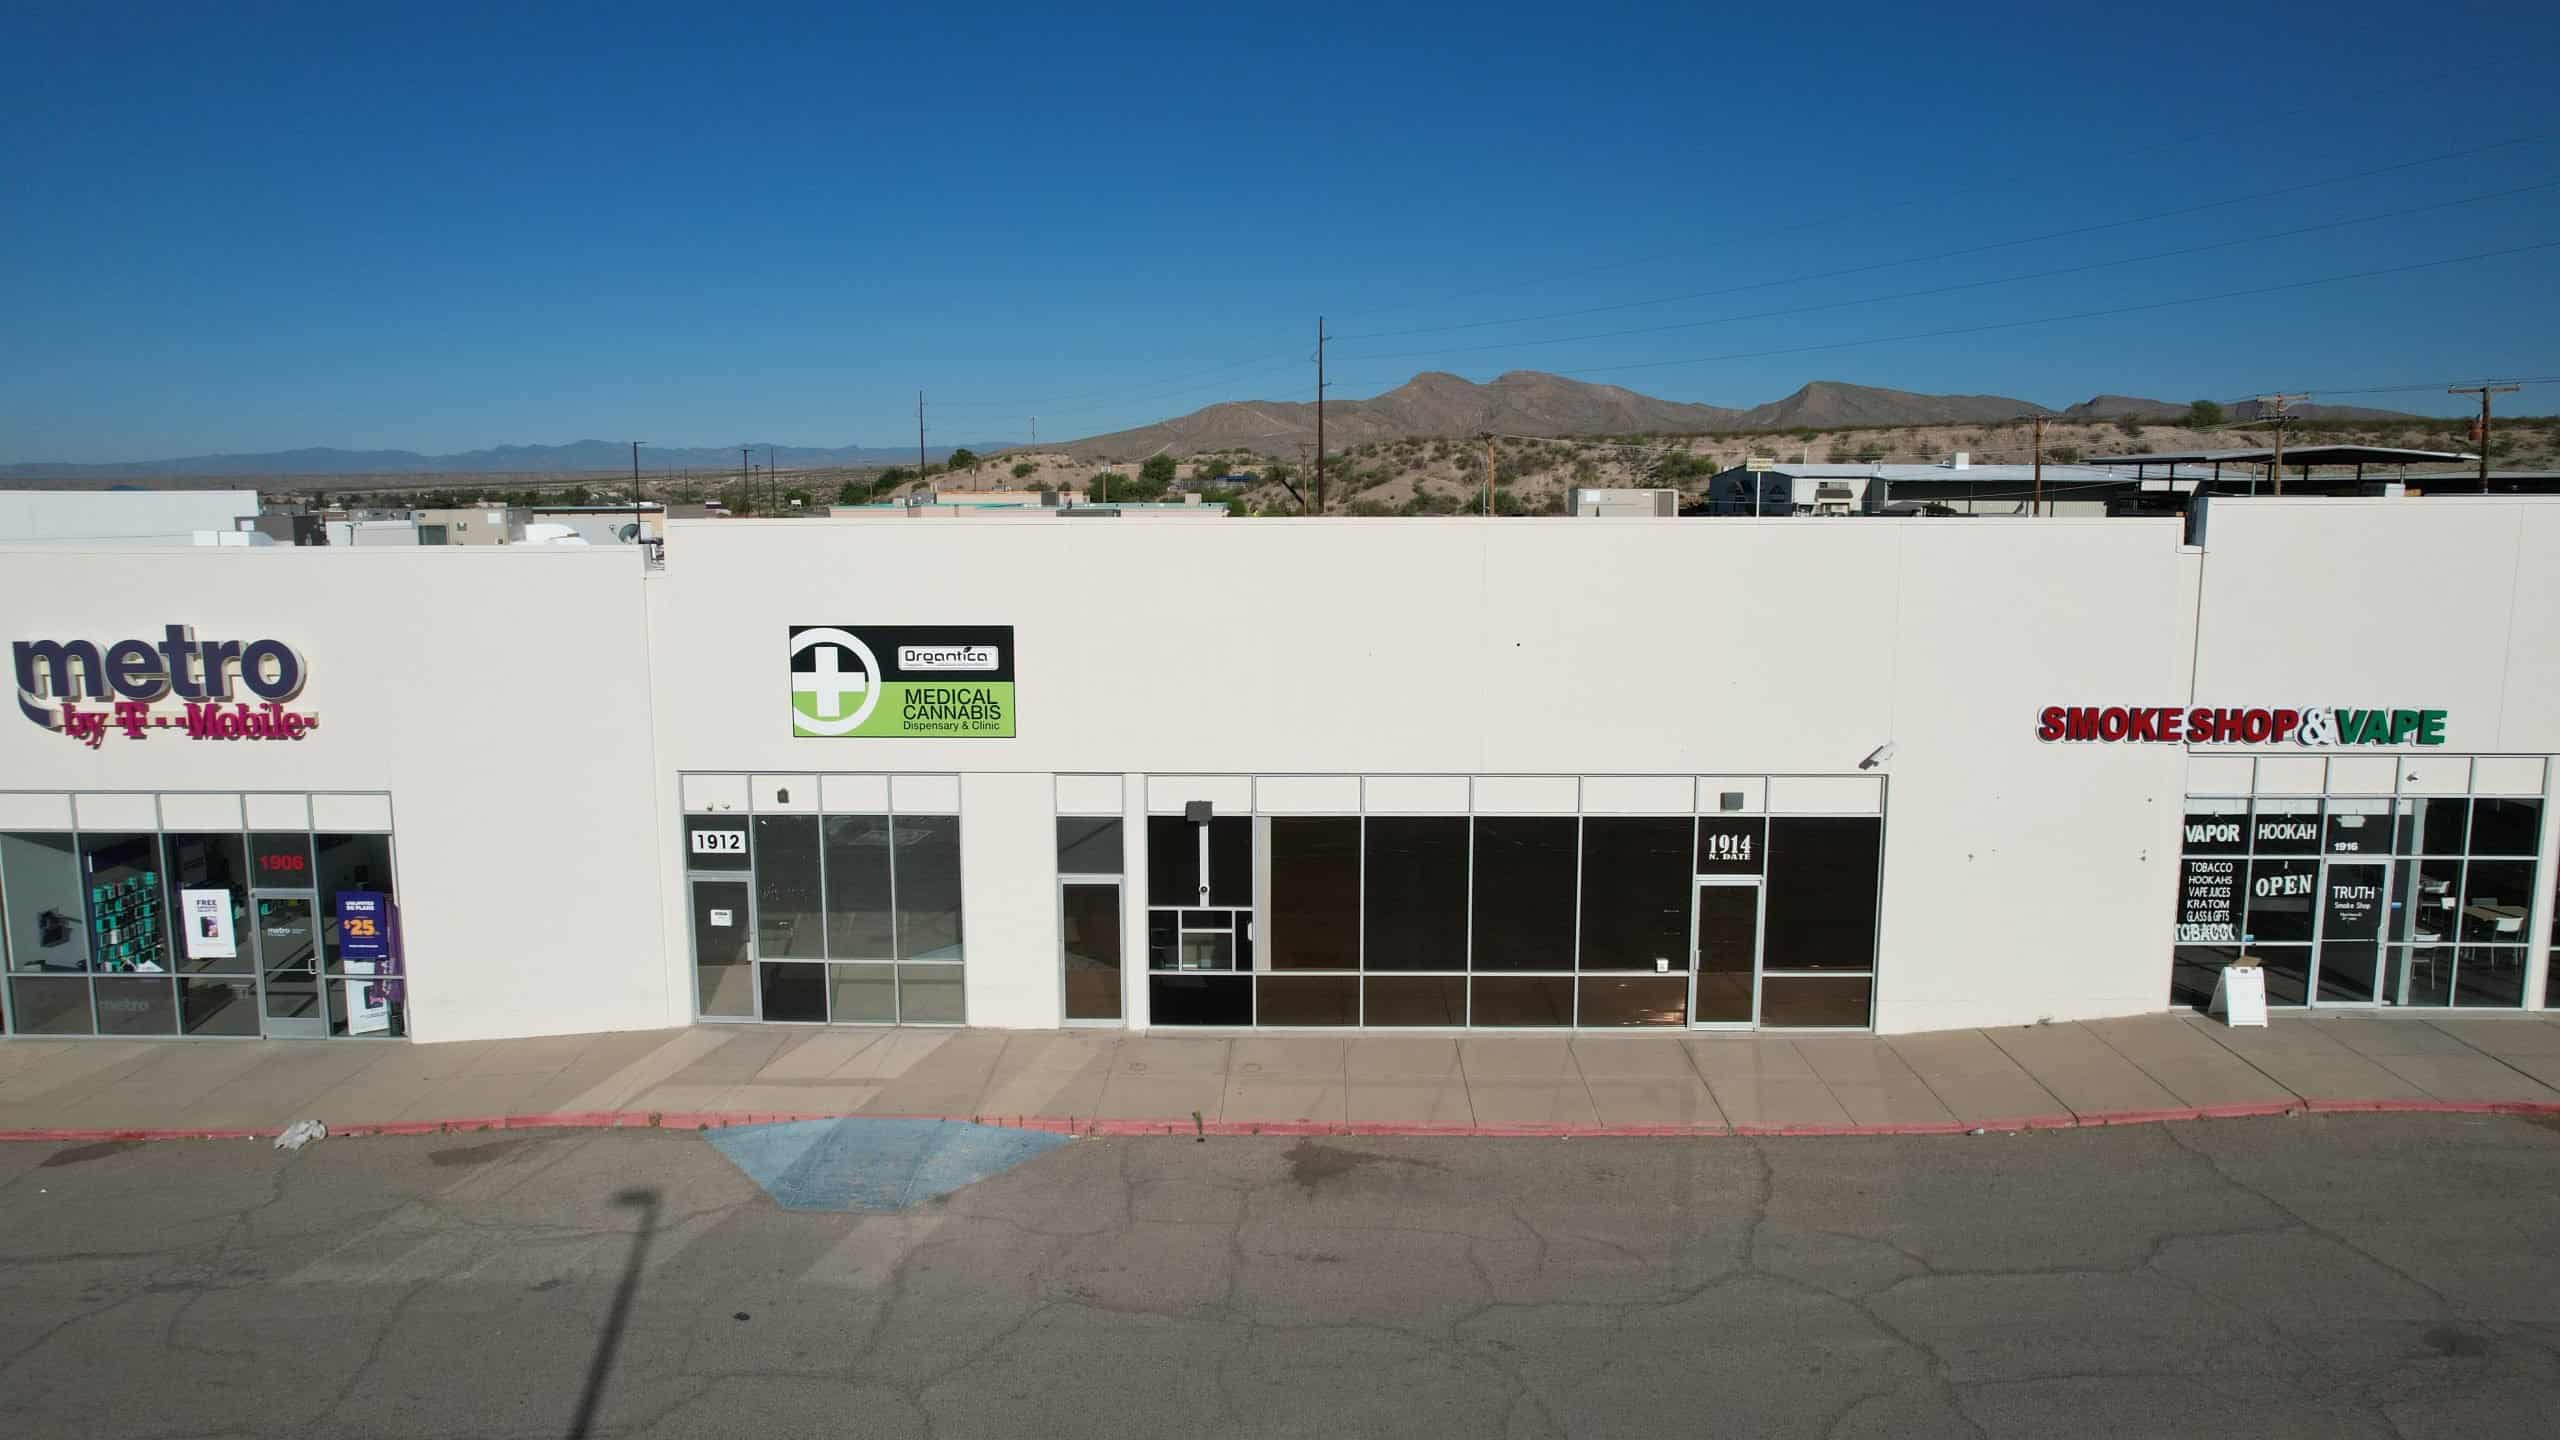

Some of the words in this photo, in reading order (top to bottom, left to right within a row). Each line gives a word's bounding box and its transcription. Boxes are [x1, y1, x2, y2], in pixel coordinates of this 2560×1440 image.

[12, 624, 304, 701] metro
[904, 688, 998, 704] MEDICAL
[903, 705, 1001, 720] CANNABIS
[61, 703, 109, 747] by
[903, 721, 959, 731] Dispensary
[962, 721, 969, 730] &
[972, 720, 1000, 730] Clinic
[2039, 706, 2184, 742] SMOKE
[2186, 708, 2299, 744] SHOP
[2299, 708, 2333, 745] &
[2335, 709, 2448, 745] VAPE
[2185, 824, 2241, 842] VAPOR
[2258, 823, 2317, 840] HOOKAH
[698, 834, 740, 849] 1912
[1709, 834, 1751, 853] 1914
[261, 854, 304, 870] 1906
[2192, 862, 2233, 873] TOBACCO
[2188, 876, 2233, 885] HOOKAHS
[2255, 874, 2313, 897] OPEN
[2333, 886, 2375, 900] TRUTH
[2187, 899, 2230, 909] KRATOM
[2334, 901, 2355, 909] Smoke
[2356, 901, 2371, 910] Shop
[2186, 910, 2207, 922] GLASS
